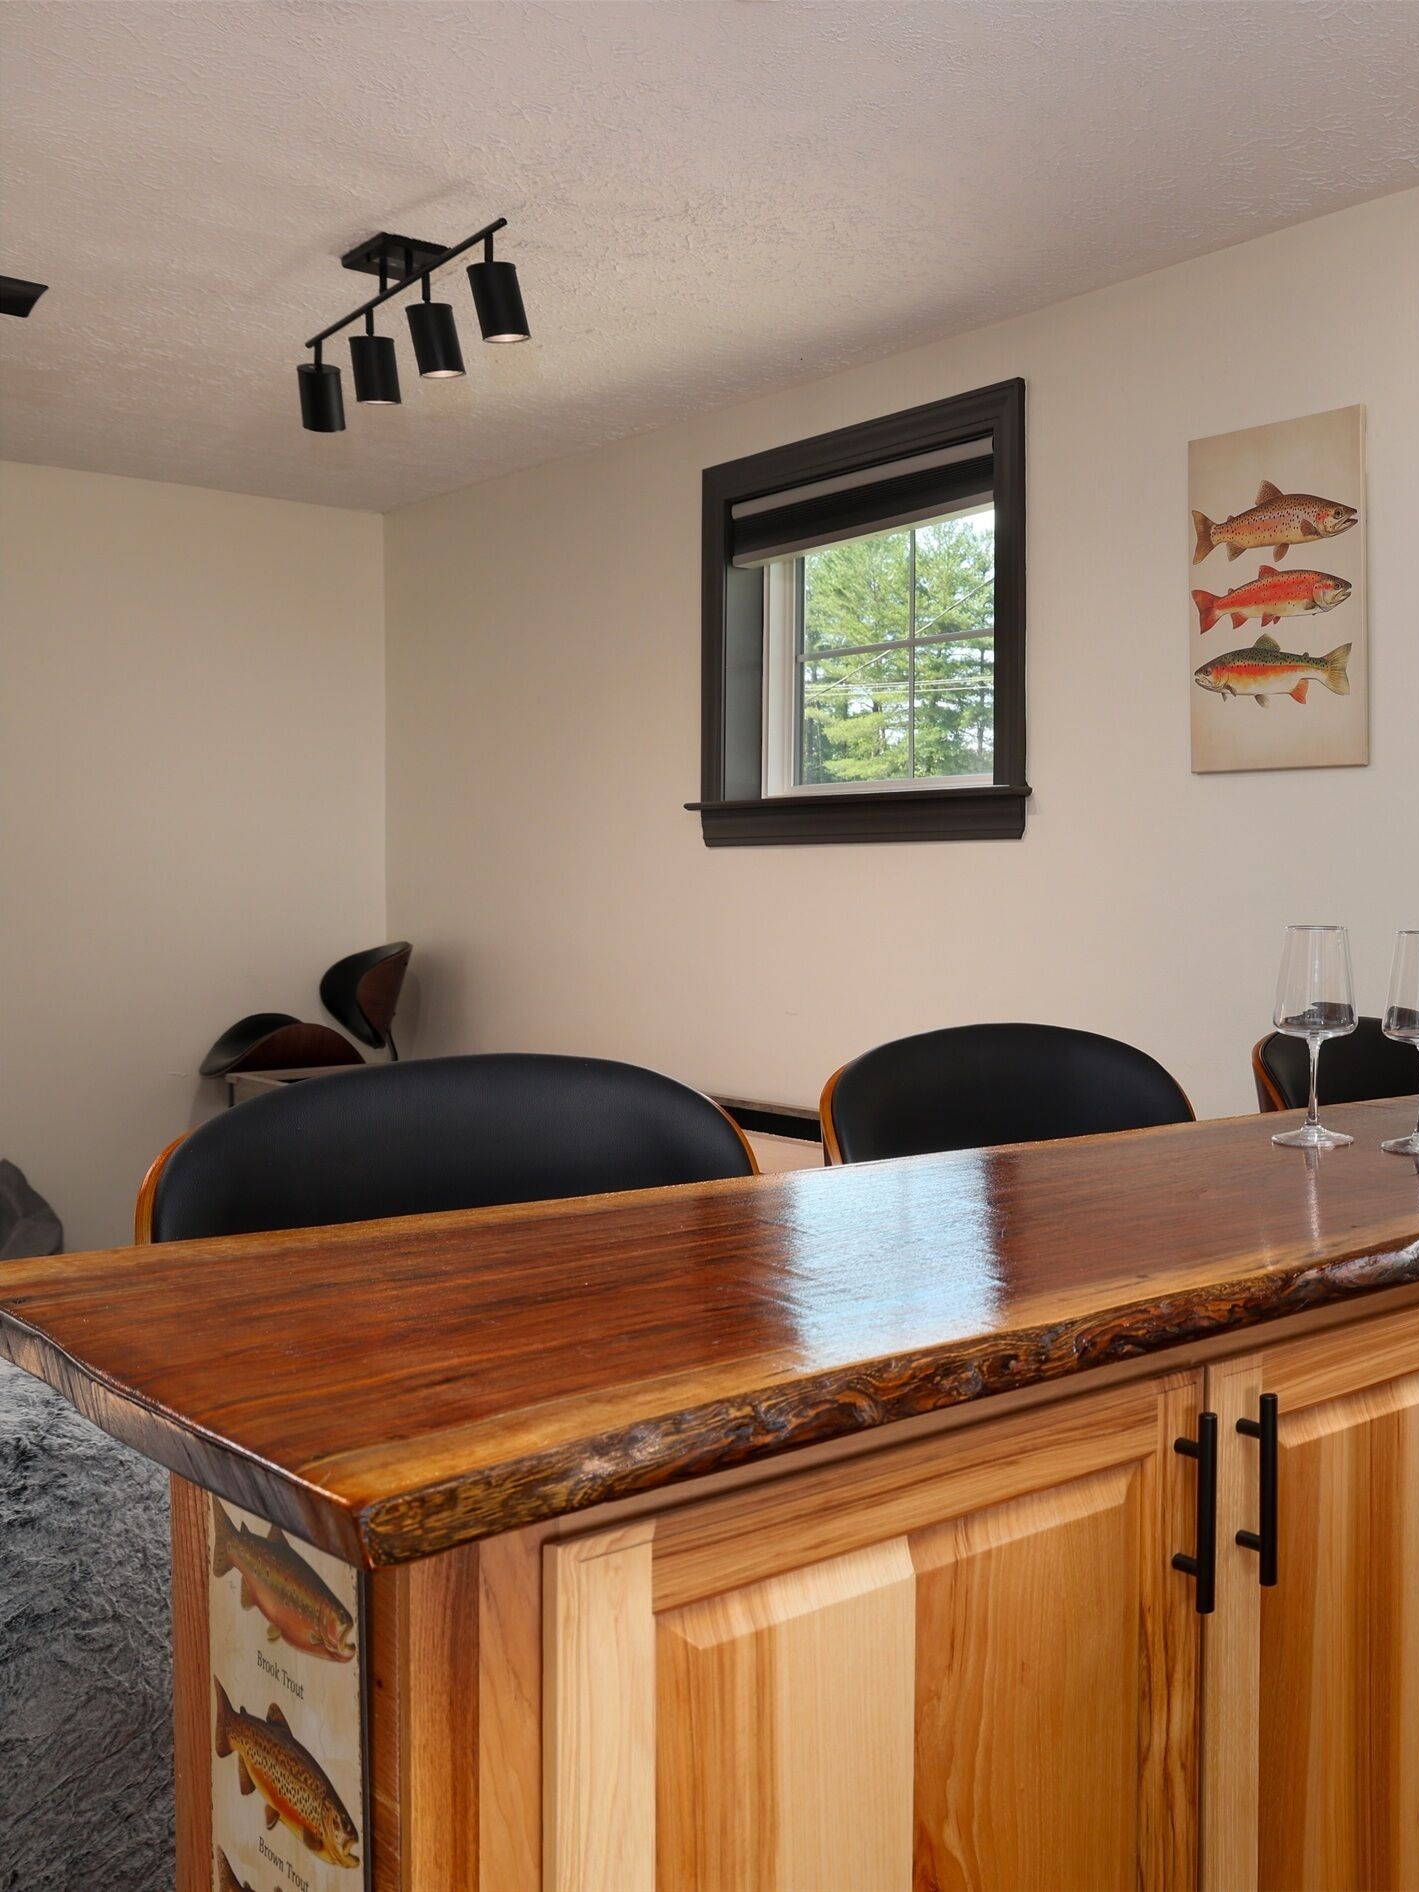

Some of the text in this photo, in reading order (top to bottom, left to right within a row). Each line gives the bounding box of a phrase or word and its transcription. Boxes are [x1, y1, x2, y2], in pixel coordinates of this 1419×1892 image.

[257, 1650, 304, 1700] Brook Trout
[259, 1836, 309, 1892] Brown Trout
